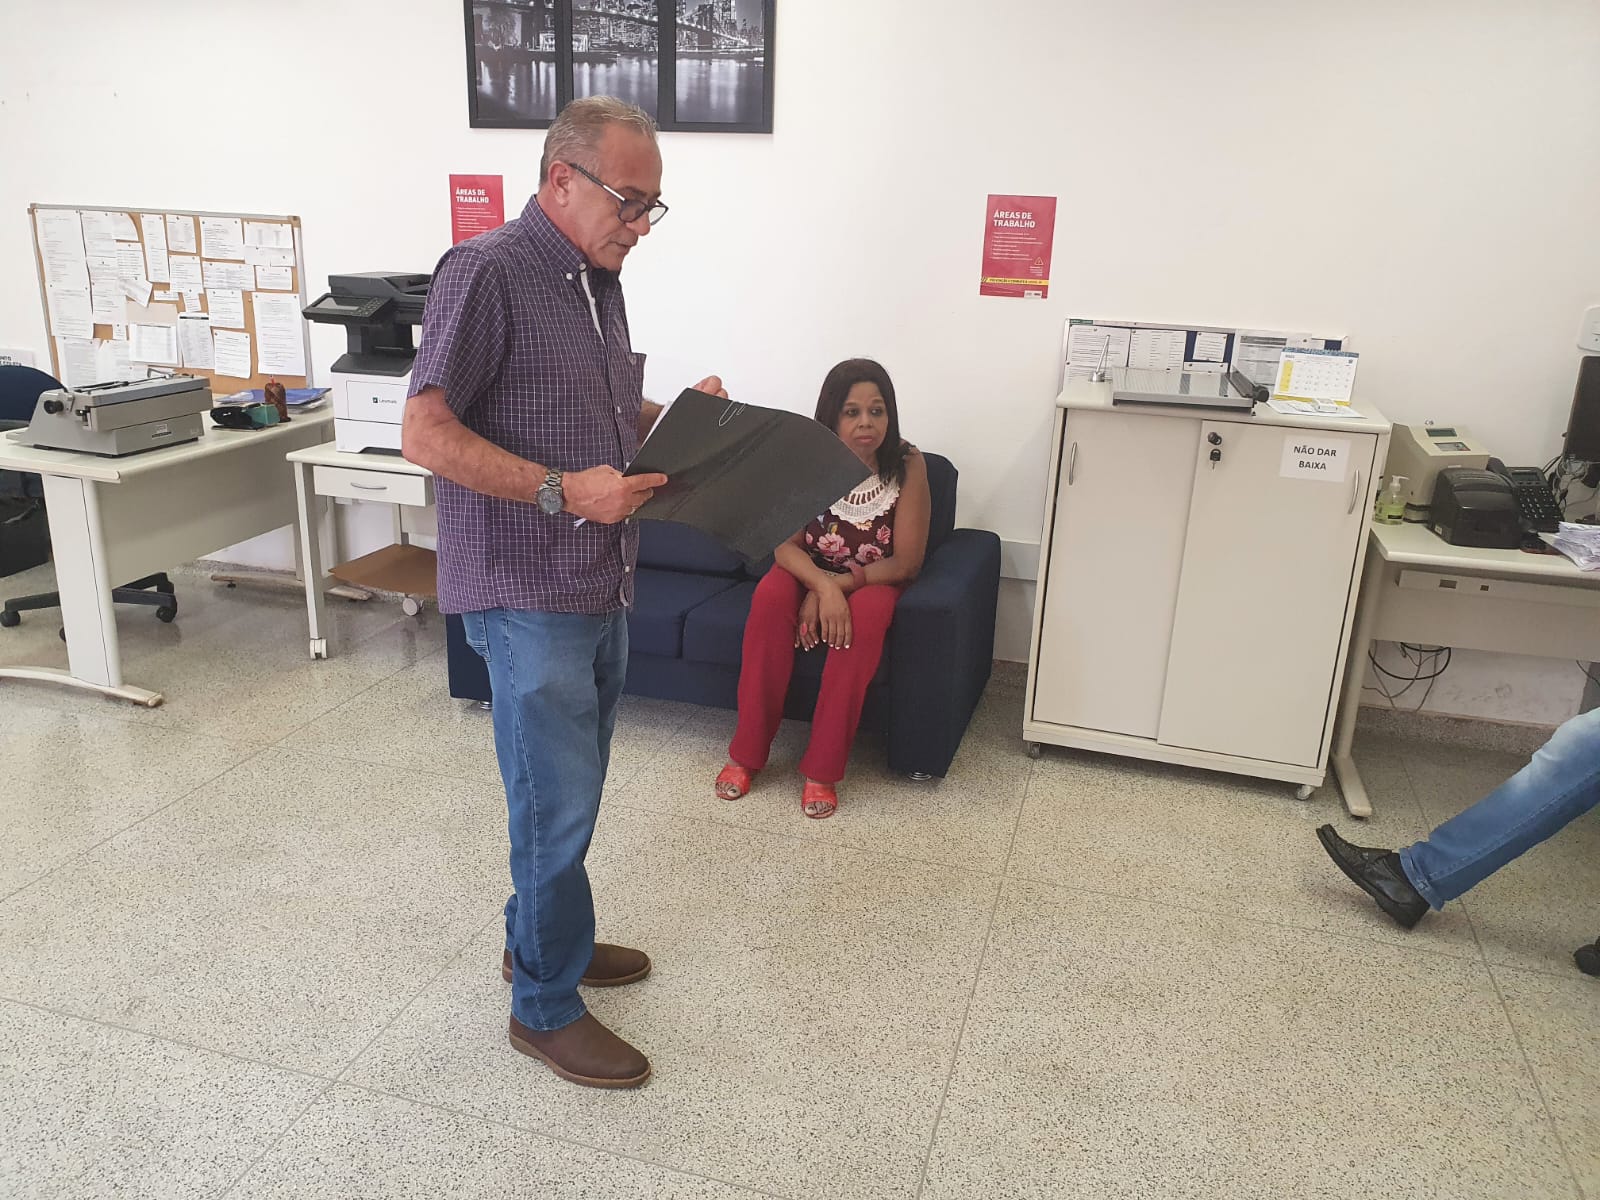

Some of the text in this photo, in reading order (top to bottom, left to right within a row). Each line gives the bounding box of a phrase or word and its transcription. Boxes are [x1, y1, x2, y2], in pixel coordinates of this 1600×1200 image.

[456, 187, 486, 196] ÁREAS DE
[993, 209, 1032, 220] ÁREAS DE
[993, 219, 1036, 228] TRABALHO
[1293, 445, 1337, 457] NÃO DAR
[1298, 460, 1327, 470] BAIXA
